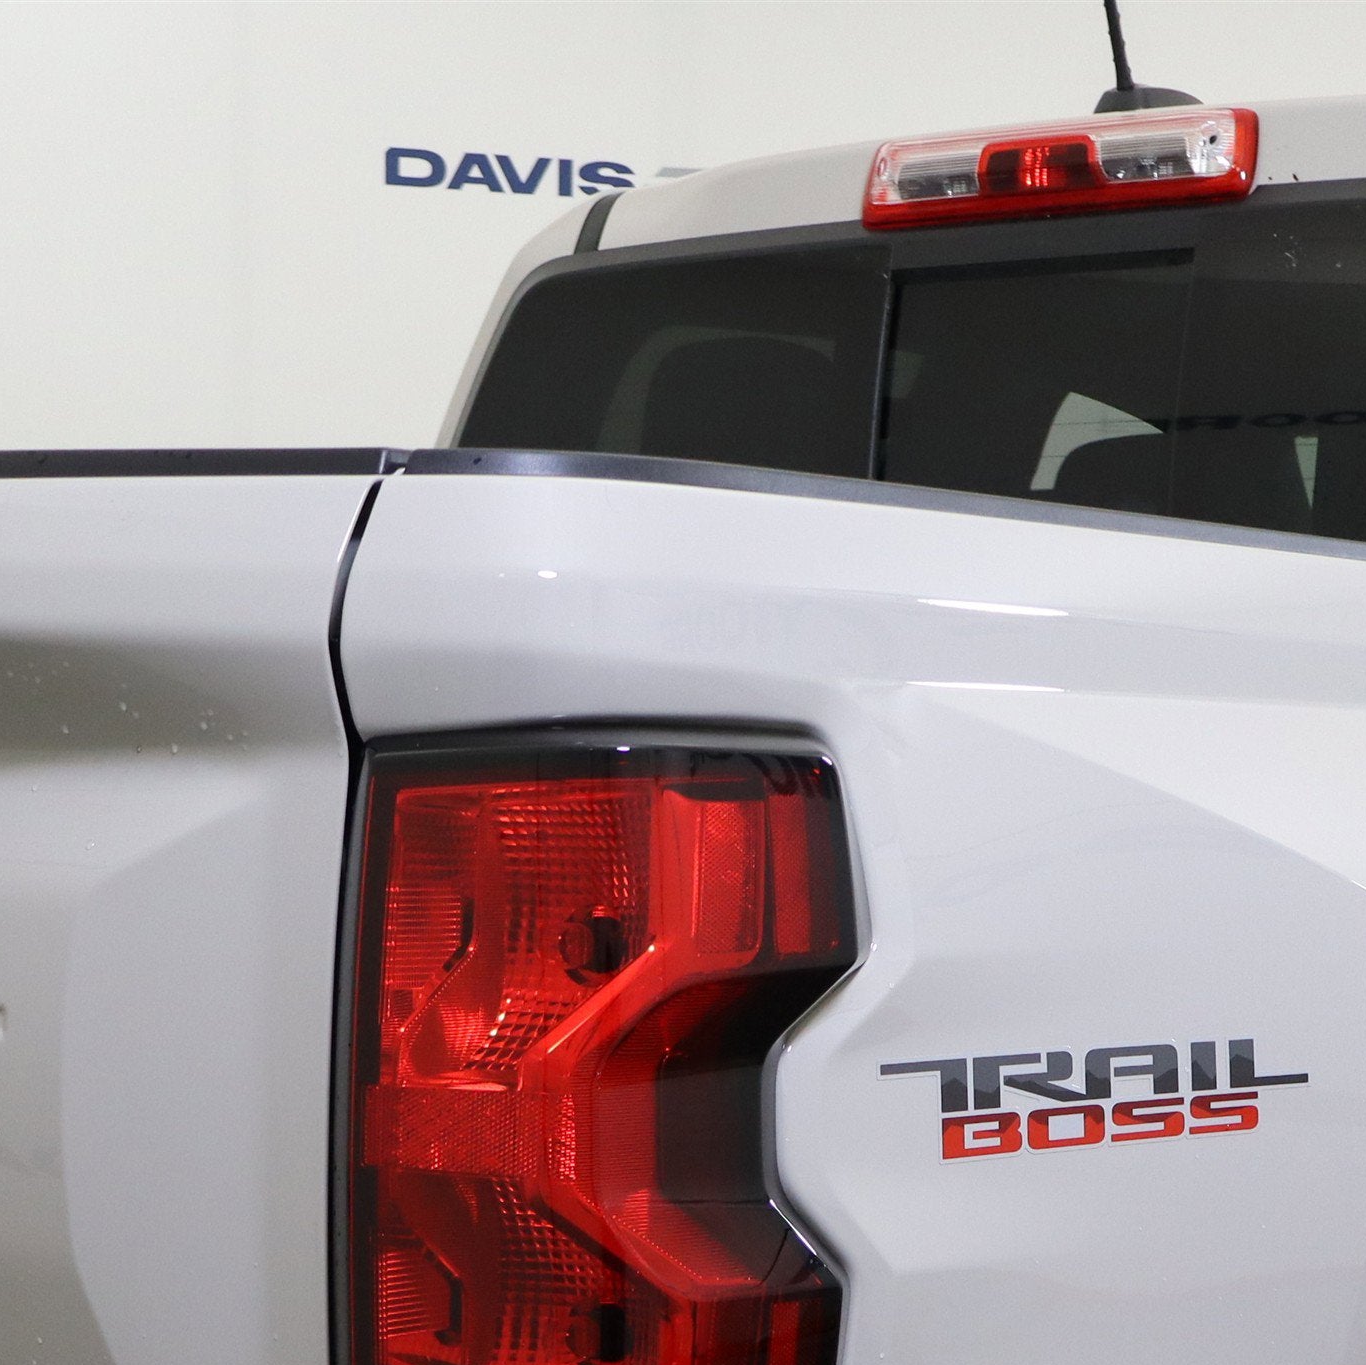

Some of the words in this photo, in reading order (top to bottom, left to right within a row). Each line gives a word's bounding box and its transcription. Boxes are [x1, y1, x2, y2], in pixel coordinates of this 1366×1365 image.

[385, 146, 635, 198] DAVIS
[879, 1038, 1309, 1113] TRAIL
[941, 1091, 1259, 1160] BOSS
